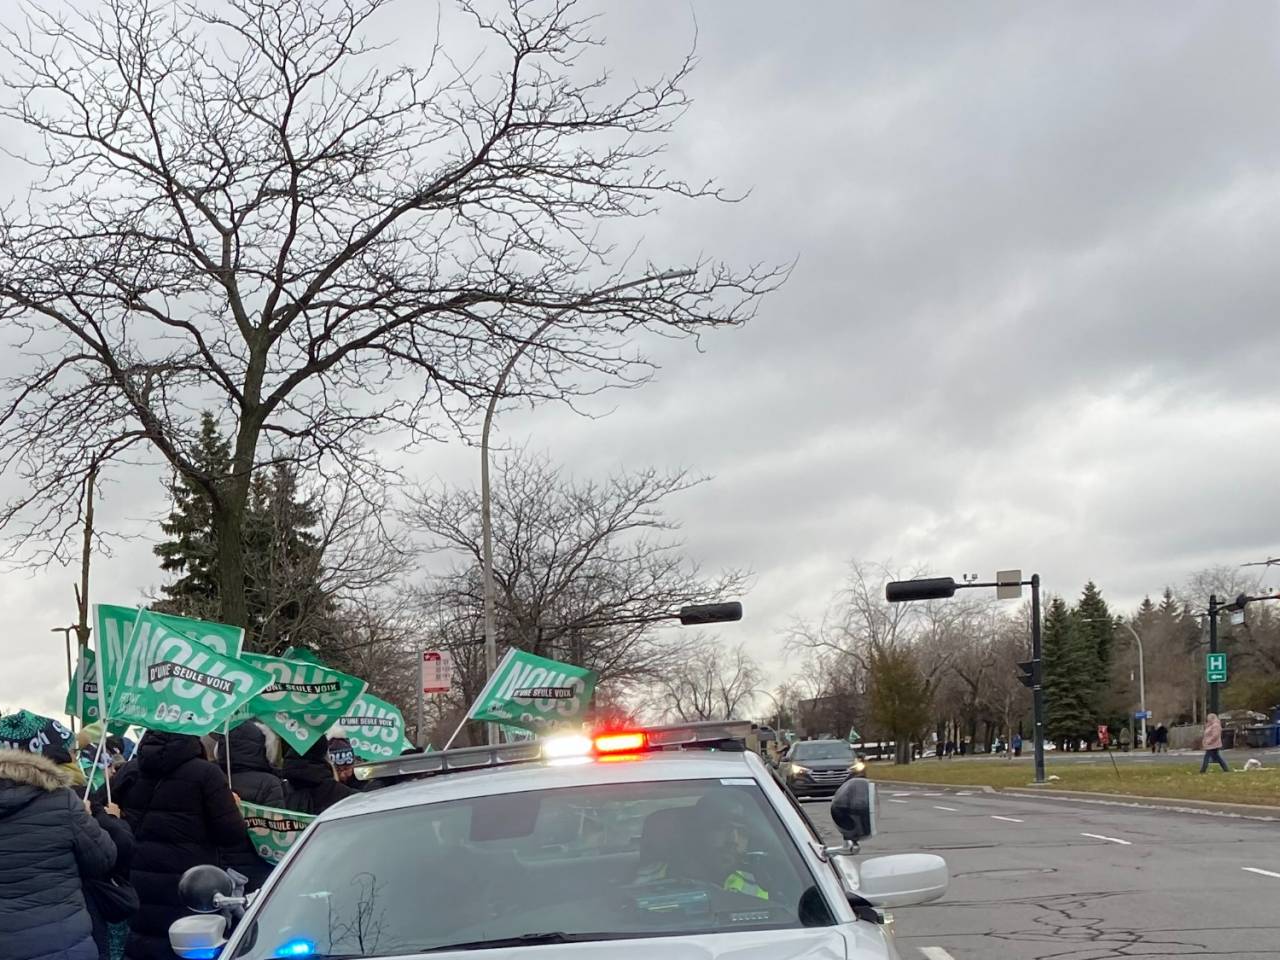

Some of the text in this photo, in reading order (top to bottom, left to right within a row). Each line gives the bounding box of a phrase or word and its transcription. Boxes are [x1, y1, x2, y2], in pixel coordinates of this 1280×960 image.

[124, 622, 253, 714] NOUS
[150, 665, 231, 692] D'UNE SEULE VOIX
[1210, 656, 1222, 670] H
[495, 660, 585, 716] NOUS
